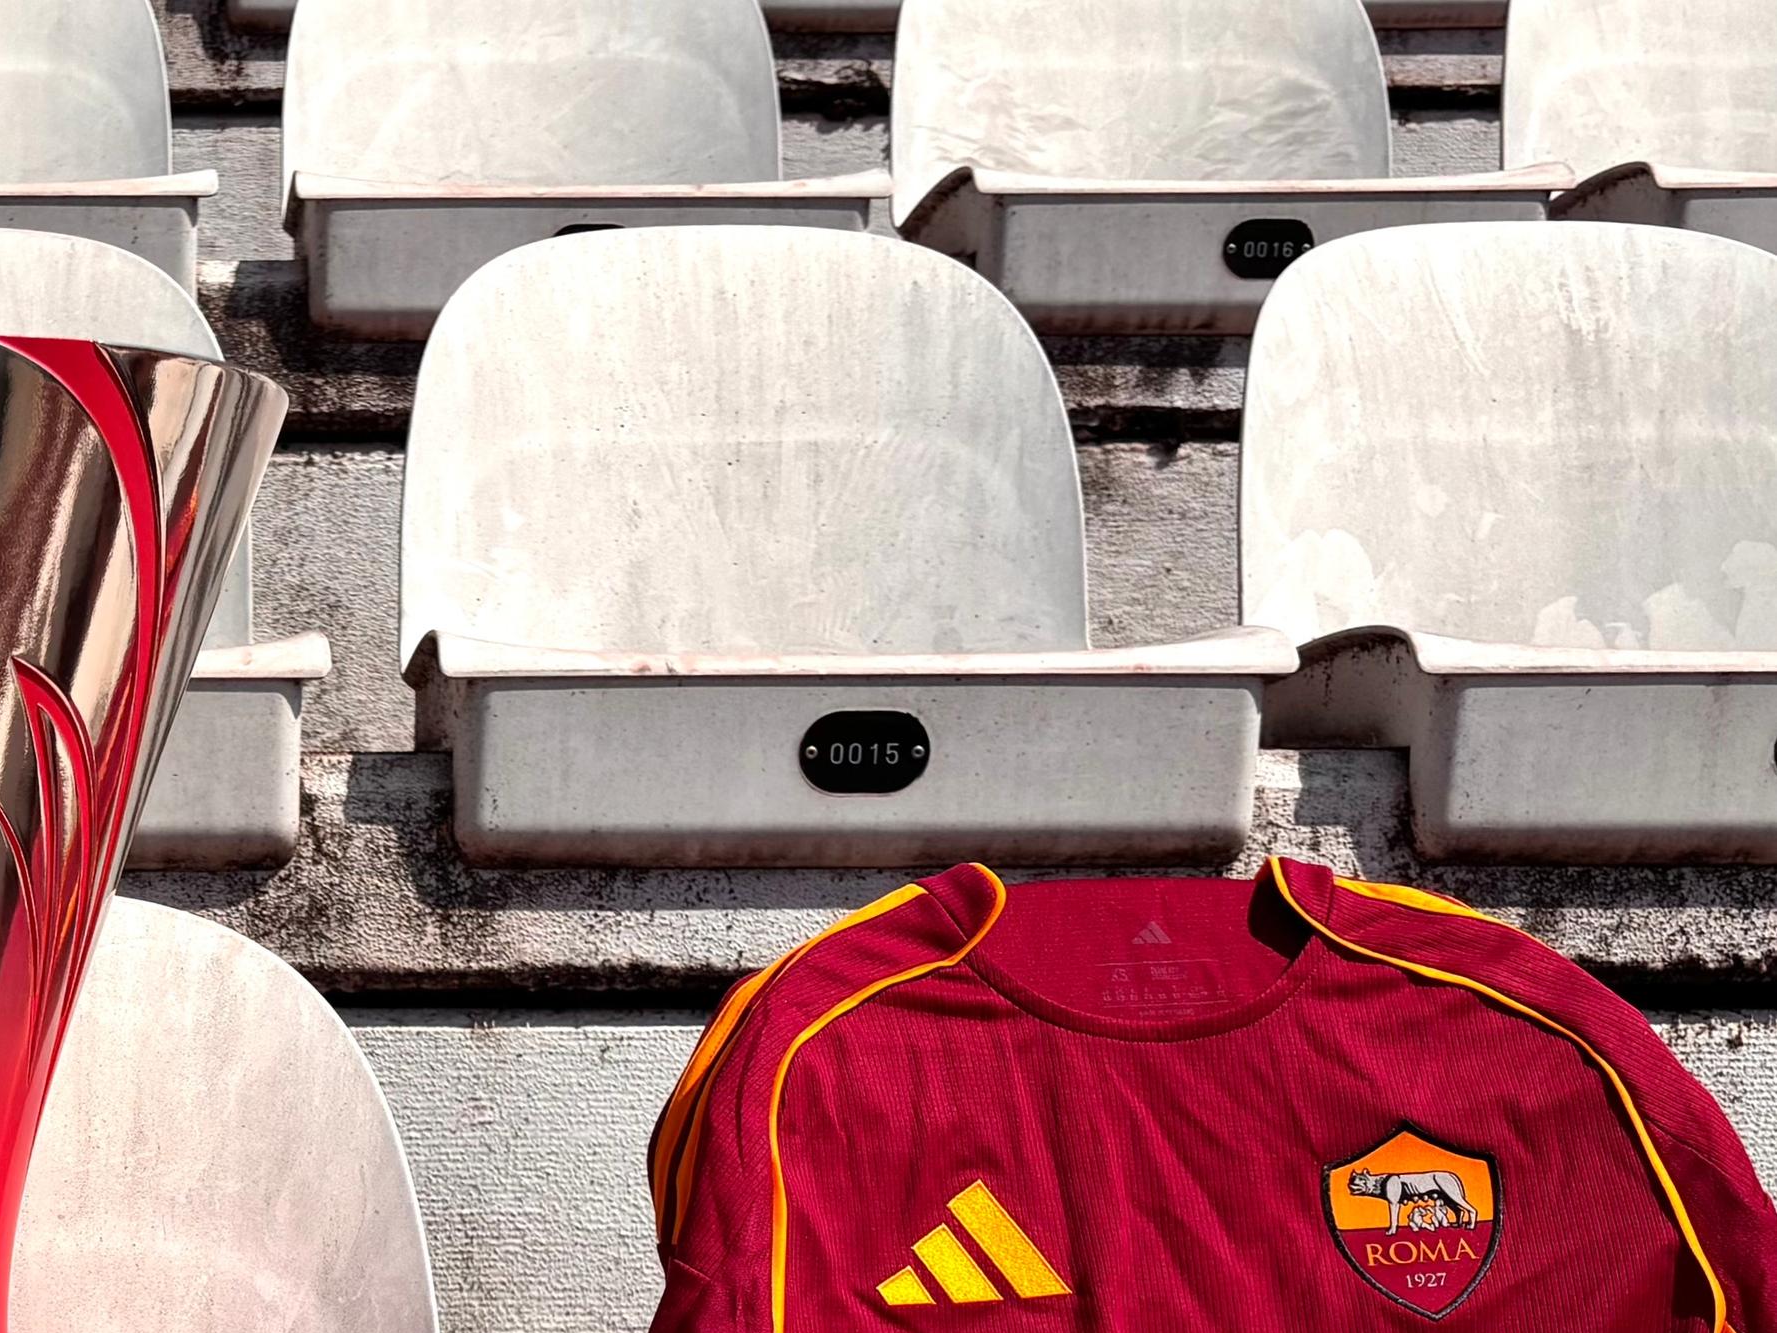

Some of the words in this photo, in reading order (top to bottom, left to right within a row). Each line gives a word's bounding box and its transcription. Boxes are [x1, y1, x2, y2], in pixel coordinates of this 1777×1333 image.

[1243, 240, 1295, 258] 0016
[829, 742, 900, 765] 0015
[1365, 1237, 1481, 1267] ROMA
[1406, 1272, 1447, 1289] 1927
